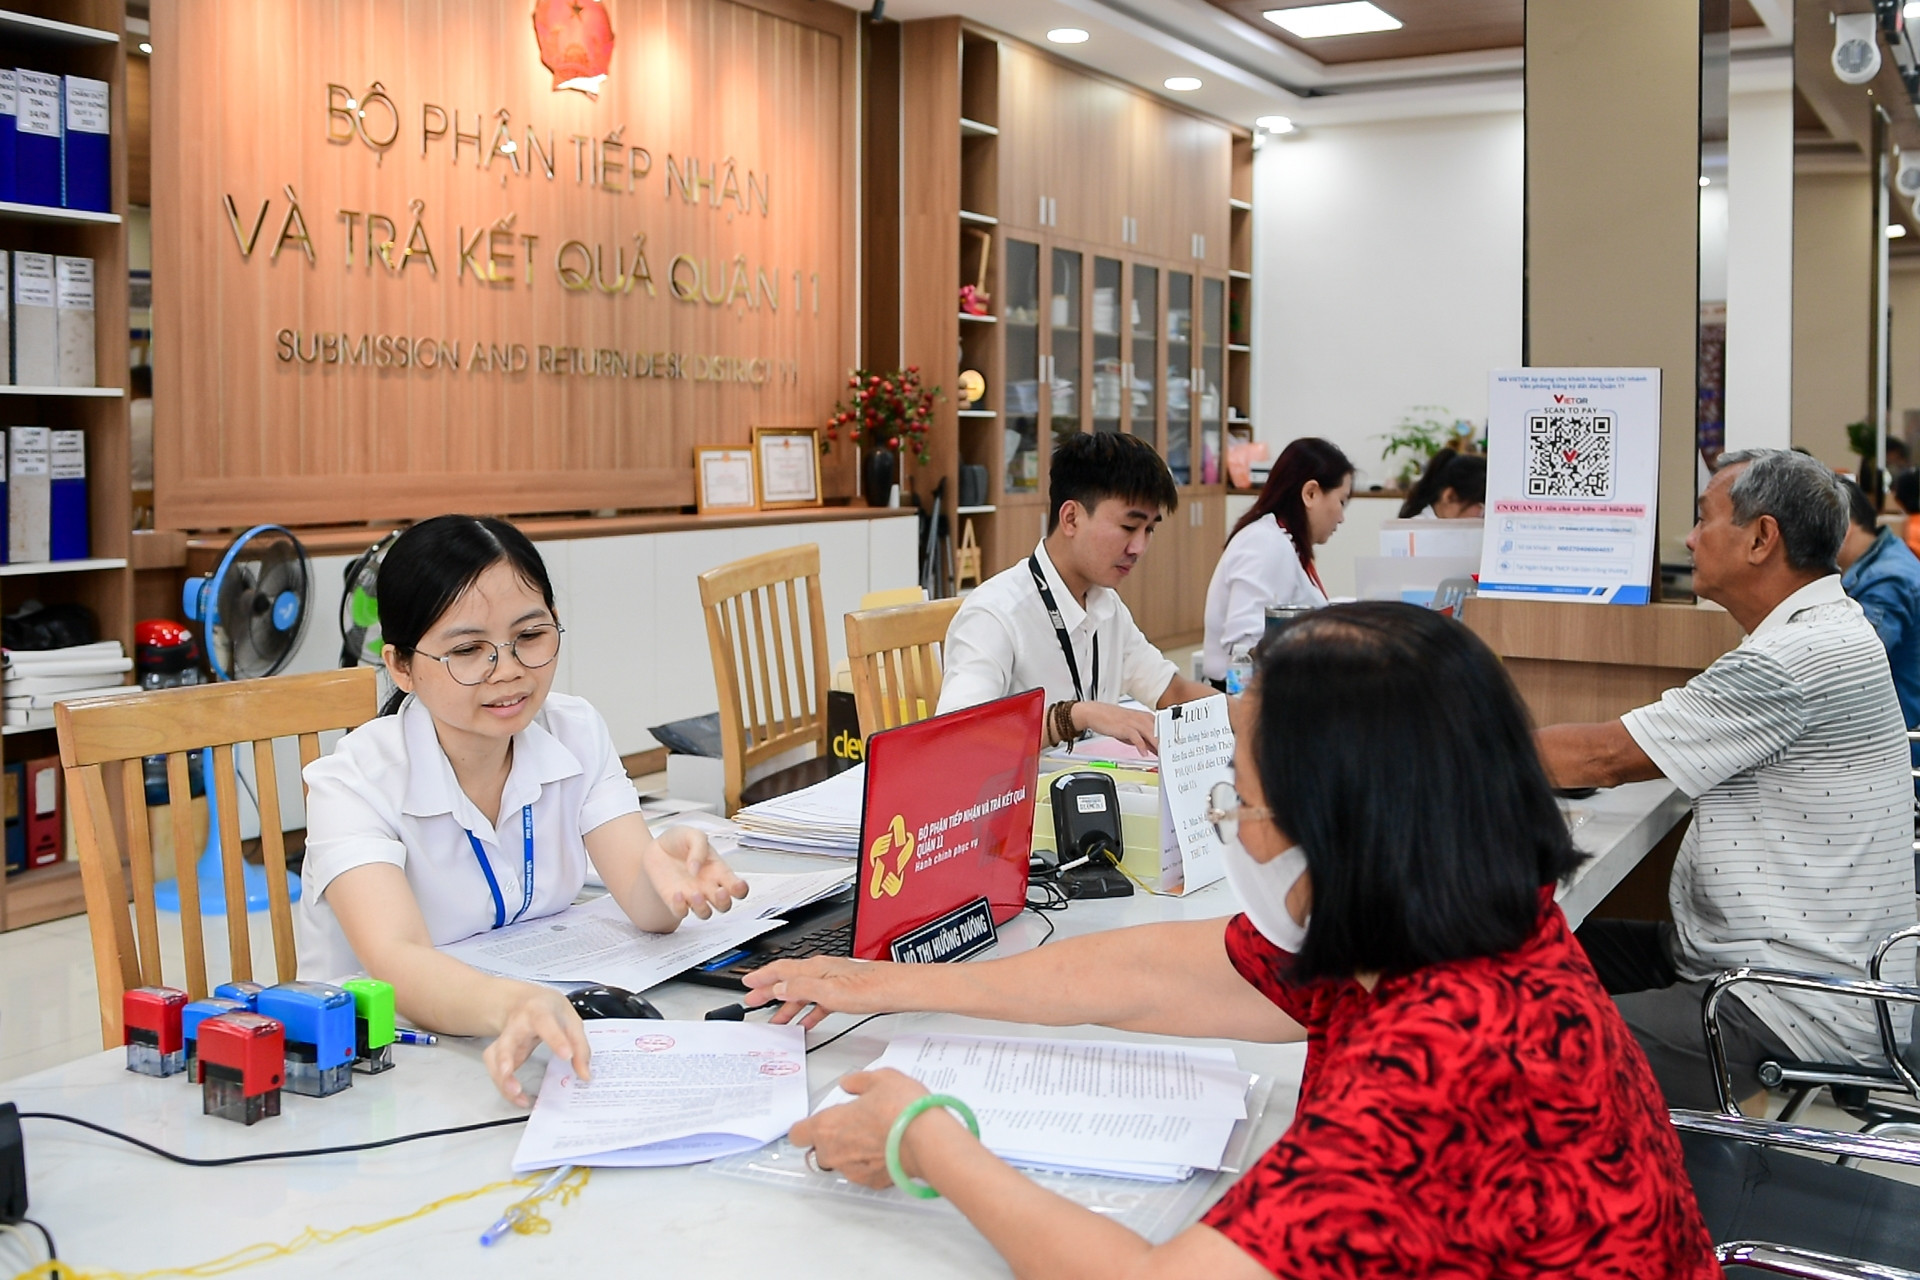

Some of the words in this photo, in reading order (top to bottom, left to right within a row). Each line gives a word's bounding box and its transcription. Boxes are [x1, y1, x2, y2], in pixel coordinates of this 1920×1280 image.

[325, 80, 399, 168] BỘ
[421, 102, 555, 189] PHẬN
[570, 125, 652, 196] TIẾP
[664, 154, 769, 223] NHẬN
[223, 184, 316, 265] VÀ
[337, 198, 437, 274] TRẢ
[457, 211, 539, 286] KẾT
[555, 231, 656, 297] QUẢ
[667, 254, 779, 322] QUẬN
[792, 269, 820, 316] 11
[275, 329, 460, 371] SUBMISSION
[466, 341, 529, 373] AND
[536, 345, 630, 378] RETURN
[634, 351, 689, 380] DESK
